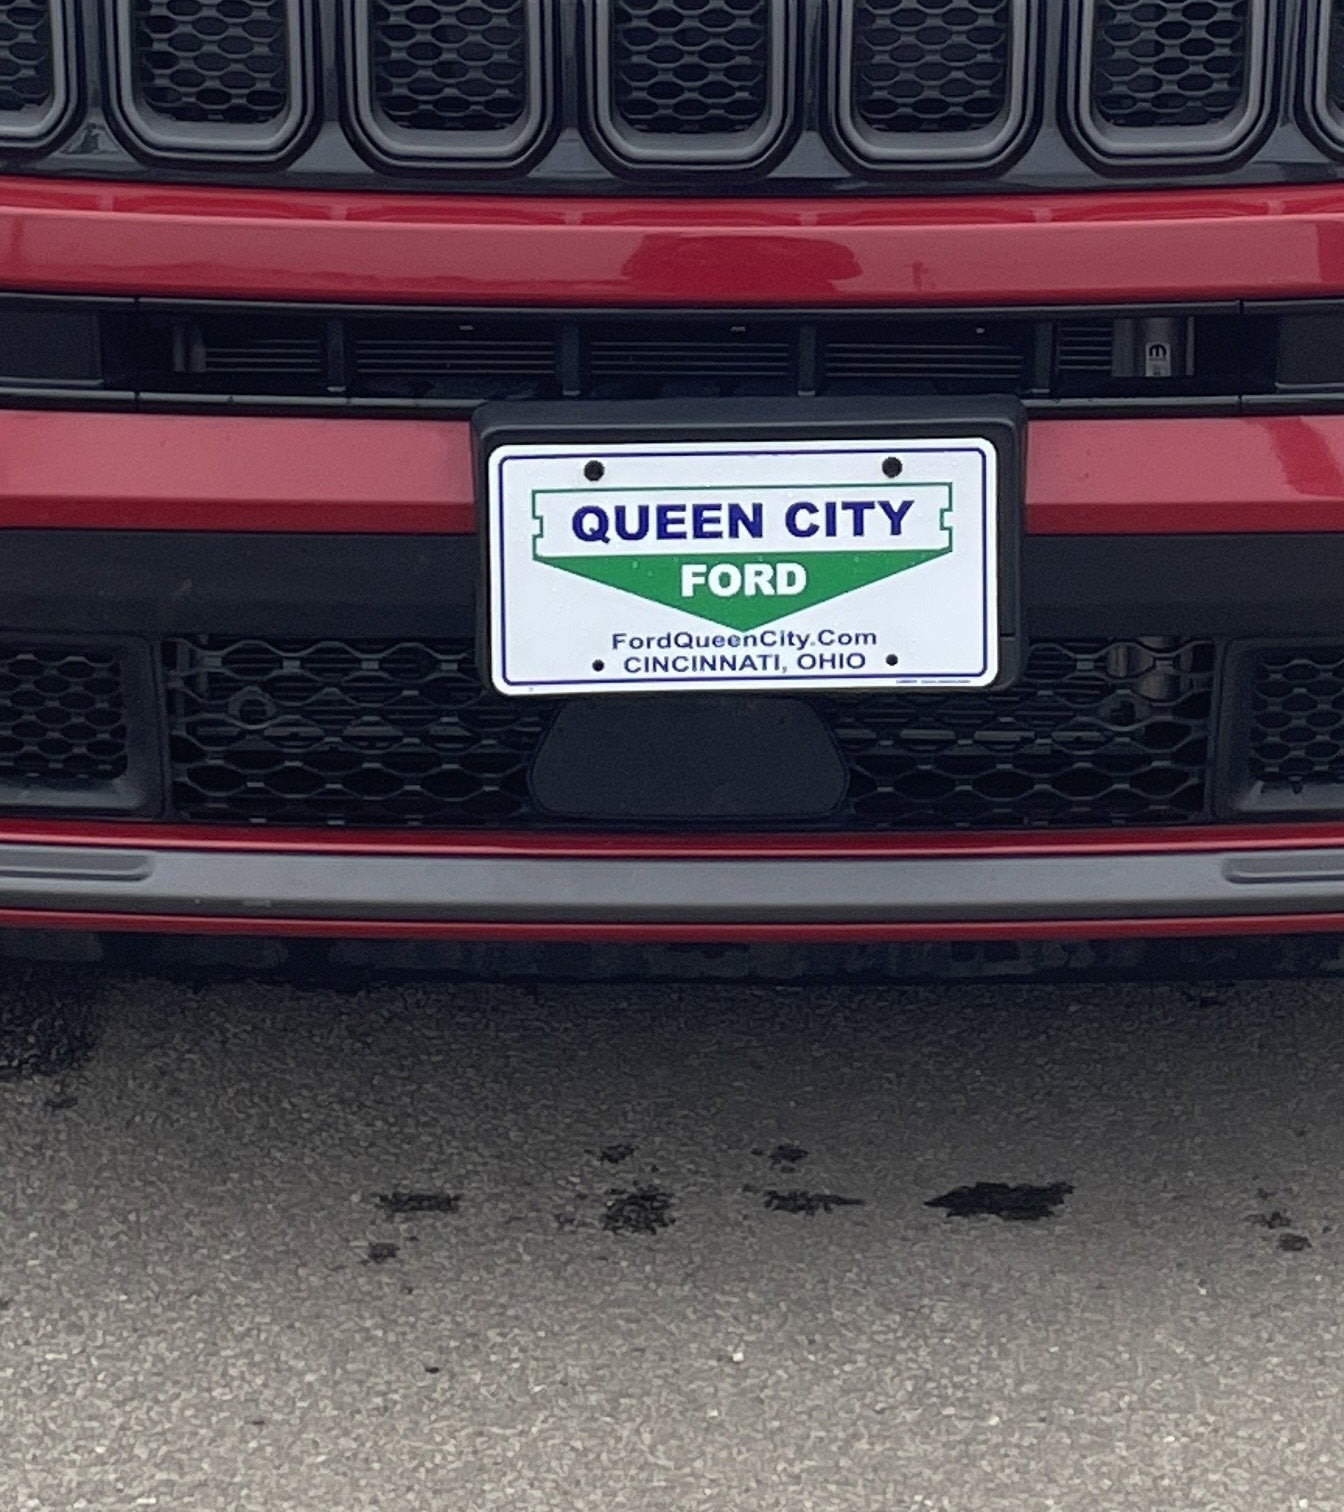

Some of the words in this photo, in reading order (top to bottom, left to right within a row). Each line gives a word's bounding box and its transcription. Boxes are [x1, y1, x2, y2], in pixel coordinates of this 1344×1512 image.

[571, 501, 764, 545] QUEEN
[784, 499, 916, 539] CITY
[680, 561, 808, 598] FORD
[611, 628, 878, 652] FordQueenCity.Com
[622, 652, 788, 674] CINCINNATI,
[796, 651, 867, 671] OHIO
